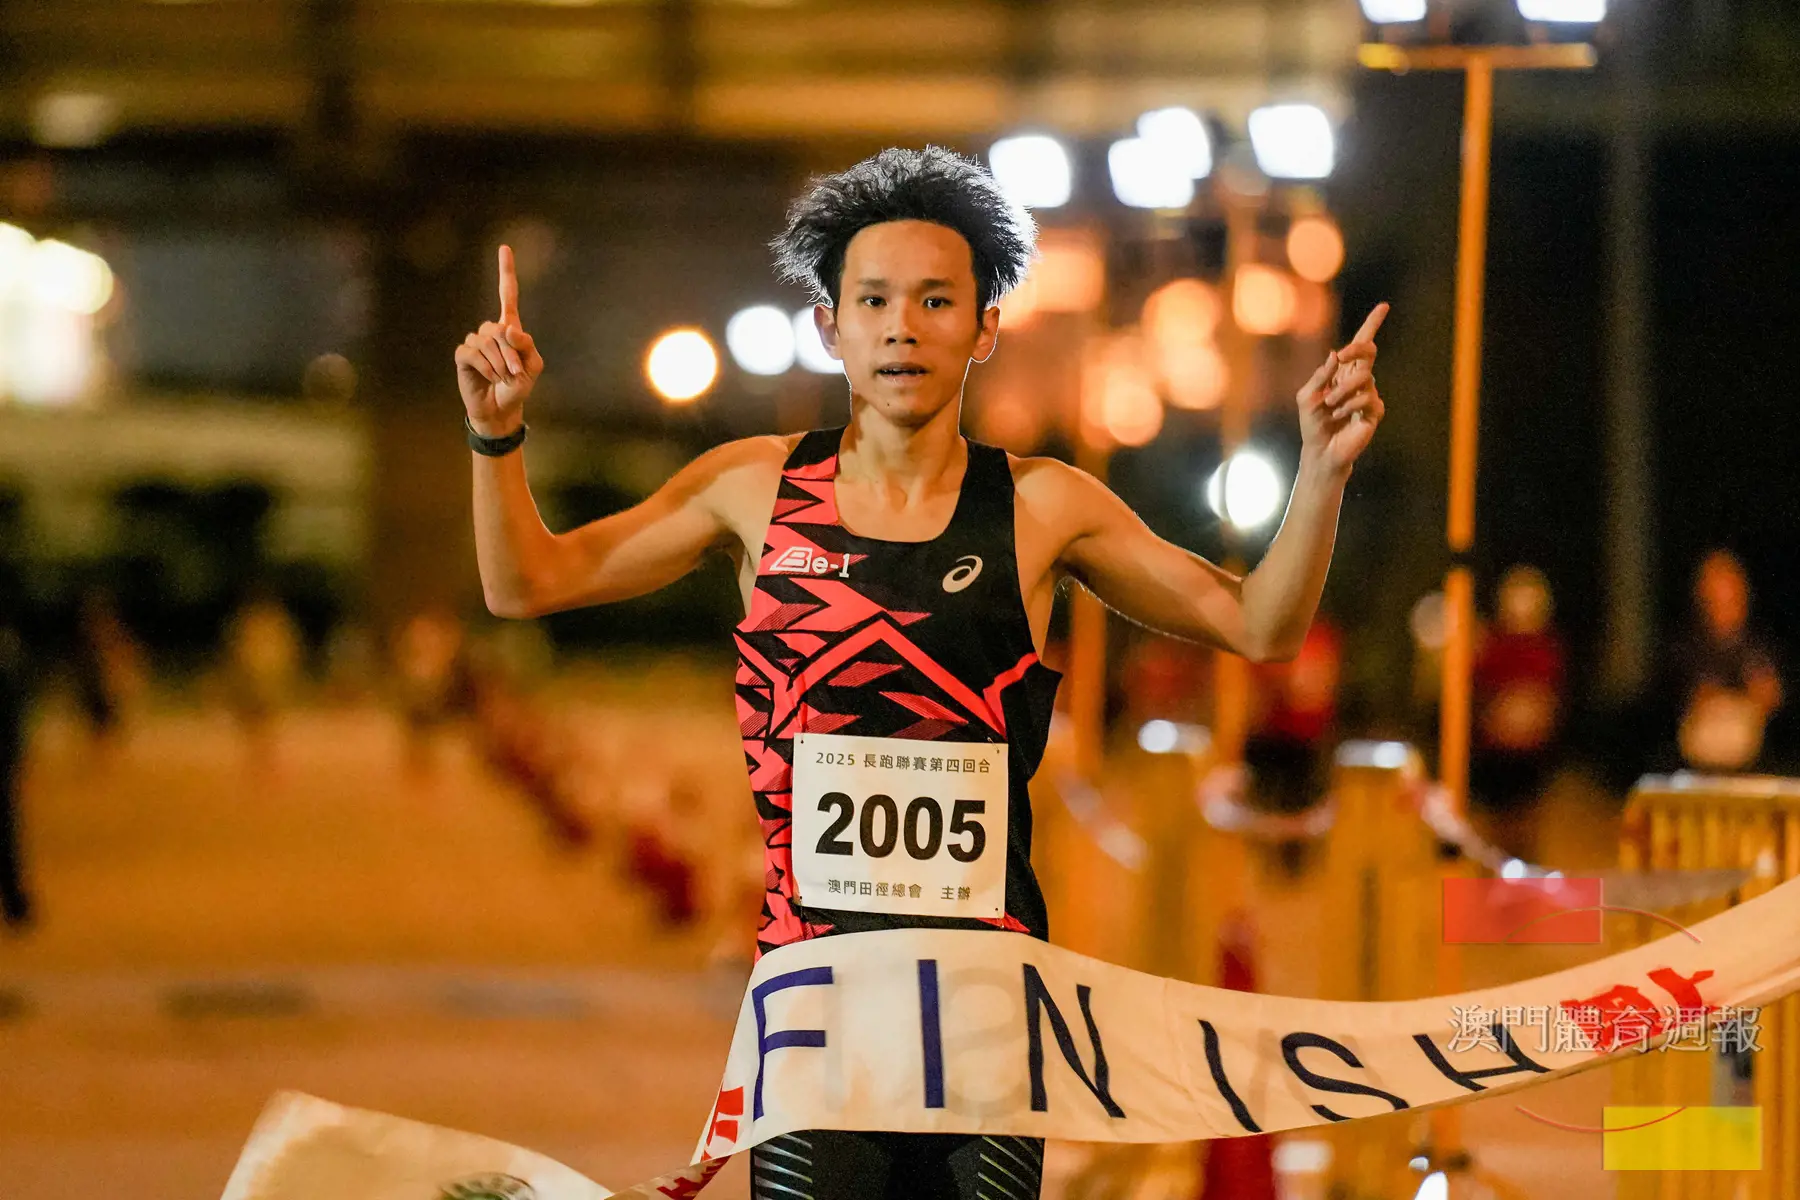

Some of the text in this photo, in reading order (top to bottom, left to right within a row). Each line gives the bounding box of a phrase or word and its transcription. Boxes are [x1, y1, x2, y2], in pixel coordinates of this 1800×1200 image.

[815, 752, 991, 774] 2025 長跑聯賽第四回合
[815, 791, 987, 863] 2005
[828, 879, 971, 901] 澳門田徑總會 主辦
[752, 959, 1551, 1133] FINISH
